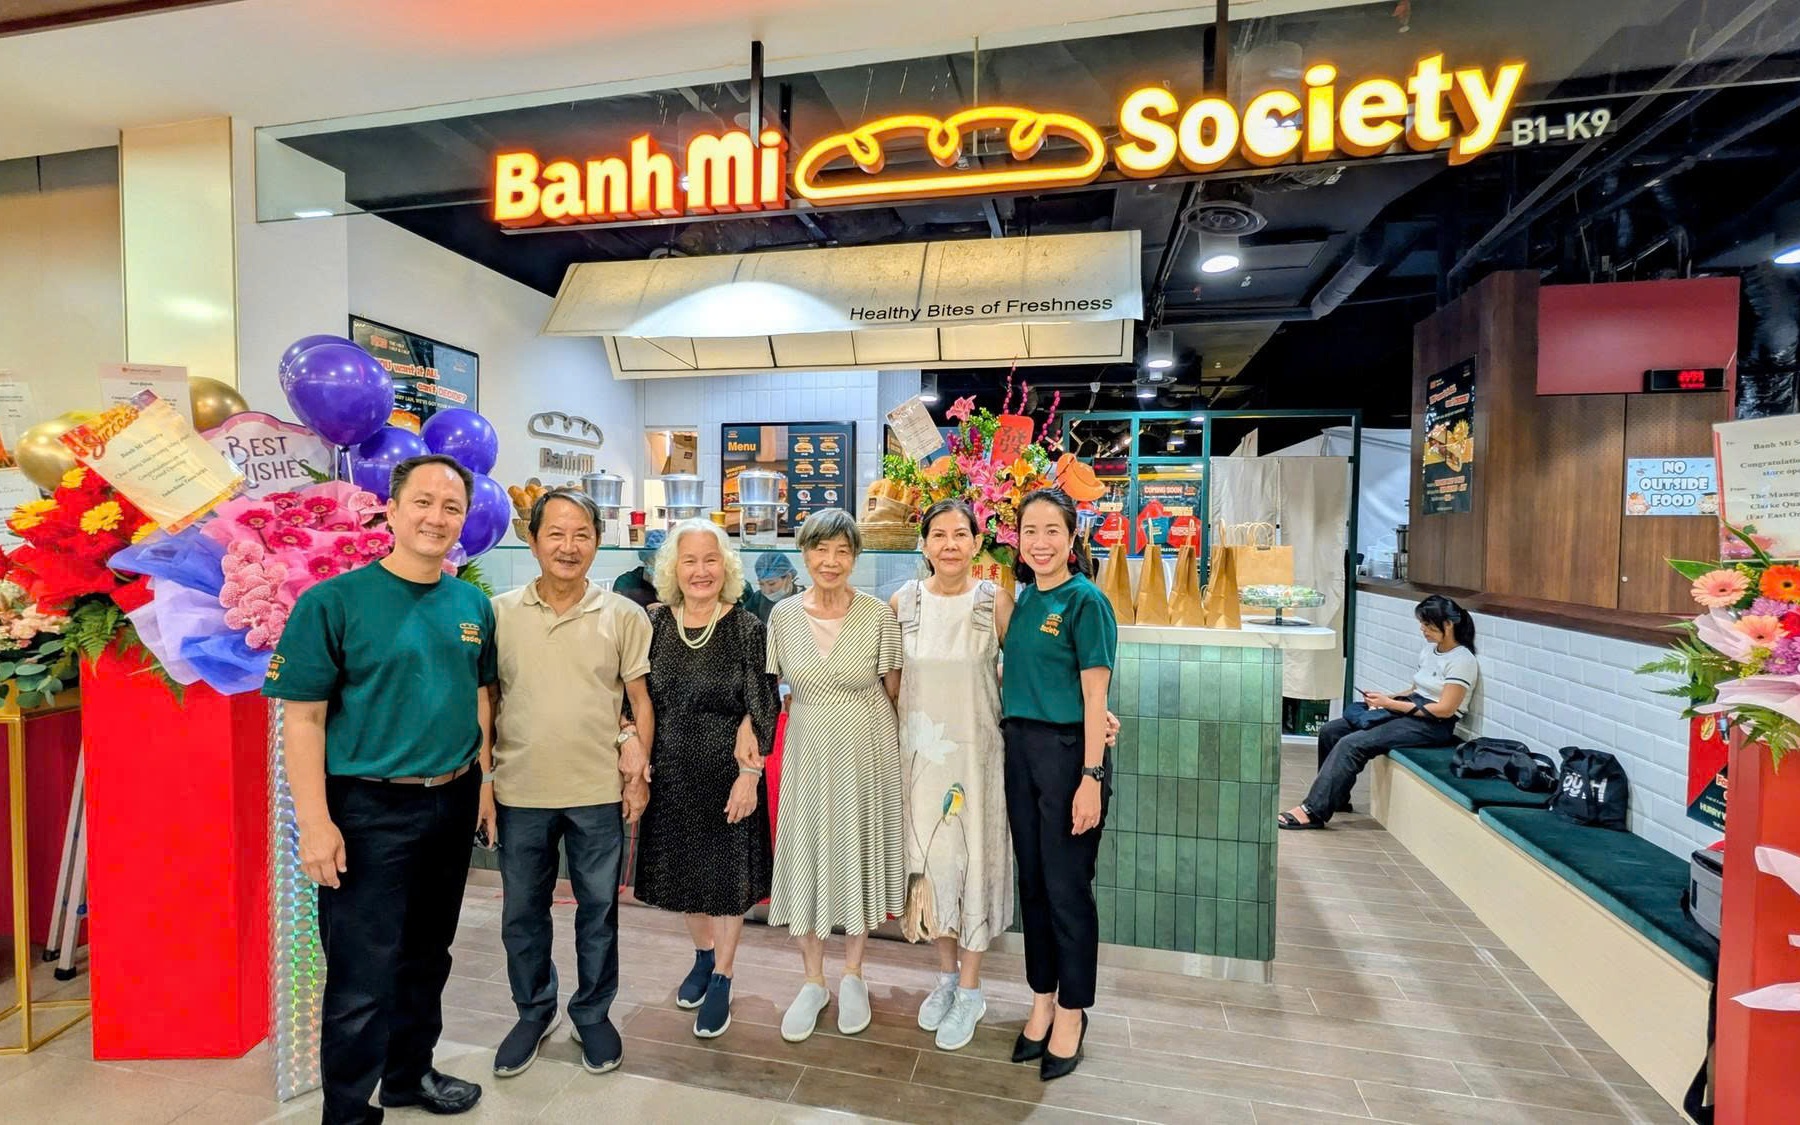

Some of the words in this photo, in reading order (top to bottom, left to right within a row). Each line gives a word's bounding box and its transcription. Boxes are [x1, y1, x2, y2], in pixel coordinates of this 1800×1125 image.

[1512, 109, 1611, 147] B1-K9
[494, 133, 680, 221] Banh
[1114, 53, 1527, 170] Society
[850, 306, 921, 322] Healthy
[927, 303, 975, 318] Bites
[981, 300, 1001, 314] of
[1006, 297, 1113, 313] Freshness
[225, 436, 287, 466] BEST
[727, 441, 757, 452] Menu
[1754, 442, 1777, 450] Banh
[1780, 440, 1792, 448] Mi
[1662, 461, 1687, 475] NO
[1763, 469, 1785, 477] store
[1144, 486, 1166, 495] COMING
[1166, 486, 1183, 495] SOON
[1639, 476, 1709, 492] OUTSIDE
[1650, 493, 1696, 508] FOOD
[1750, 502, 1780, 510] Clarke
